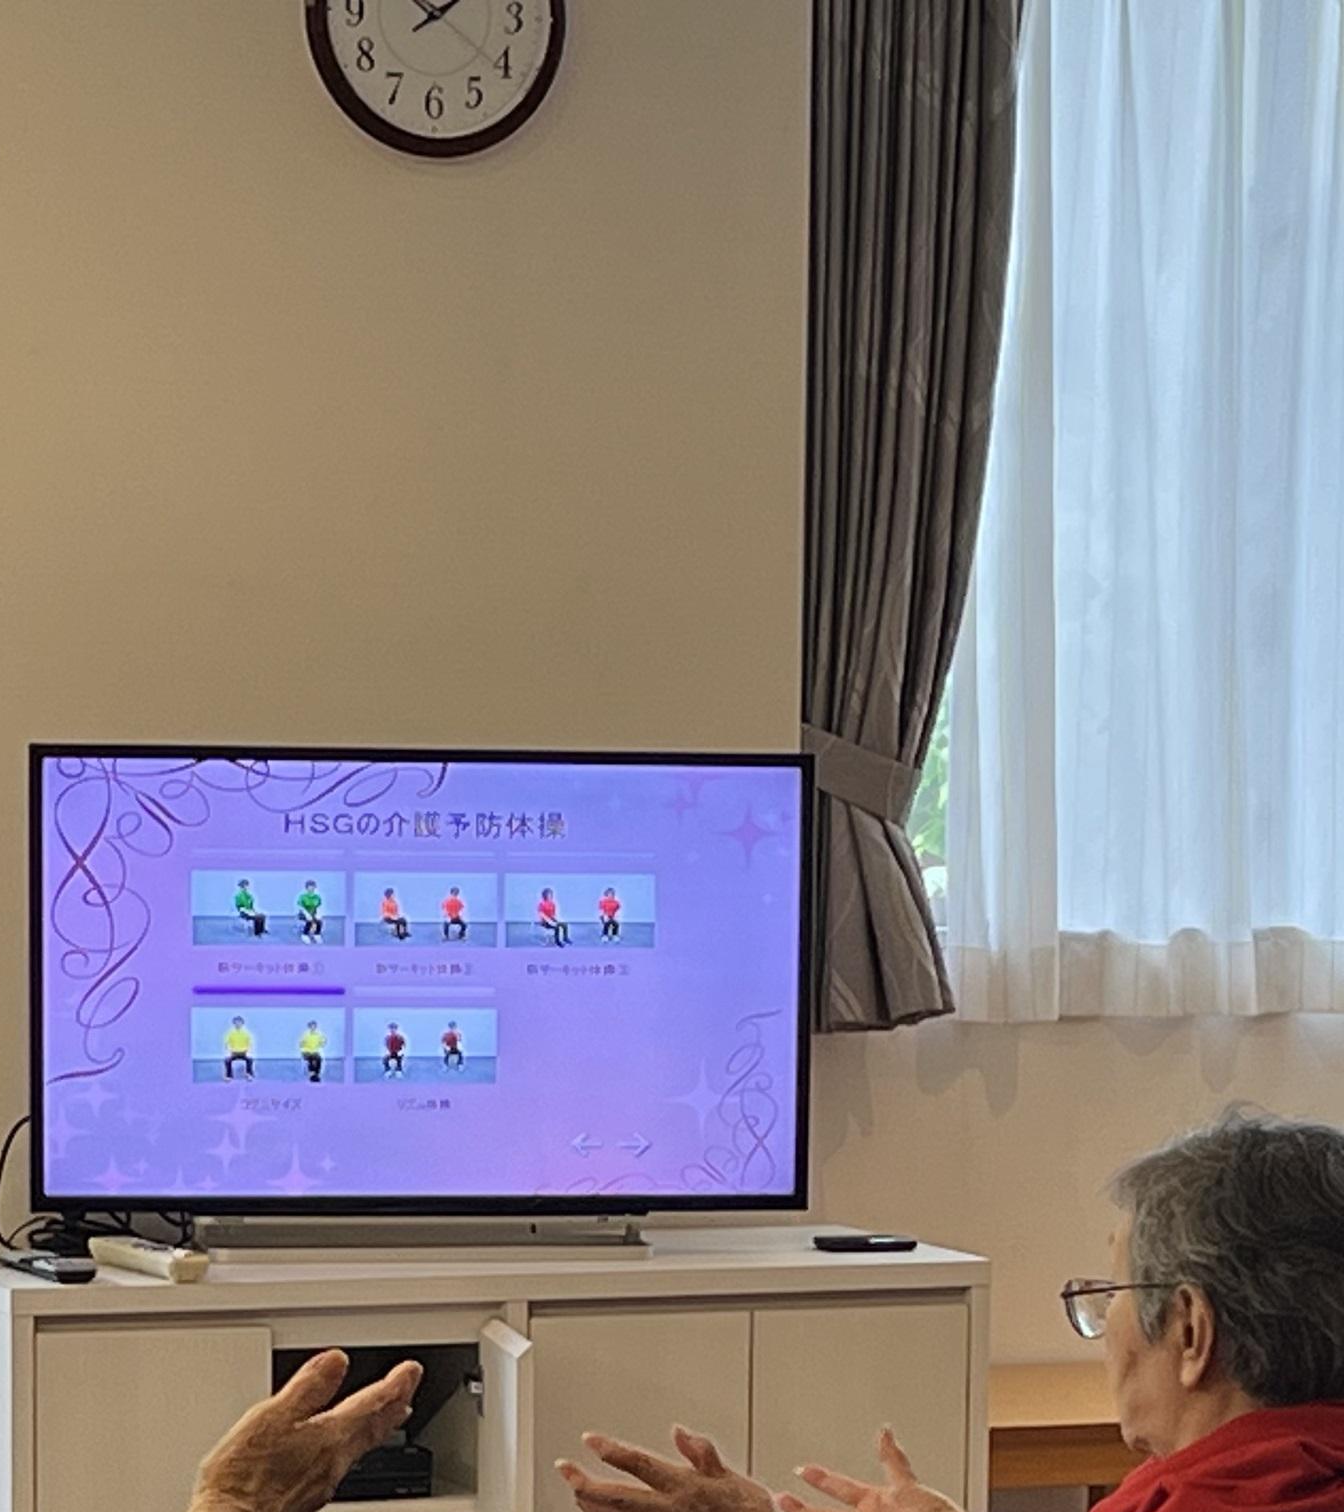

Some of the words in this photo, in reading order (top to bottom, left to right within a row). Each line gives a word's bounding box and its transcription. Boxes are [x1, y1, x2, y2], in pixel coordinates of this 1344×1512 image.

[504, 1, 524, 35] 3
[356, 36, 375, 72] 8
[494, 45, 512, 79] 4
[385, 72, 403, 105] 7
[424, 85, 444, 120] 6
[465, 76, 483, 109] 5
[283, 811, 566, 839] HSGの介護予防体操
